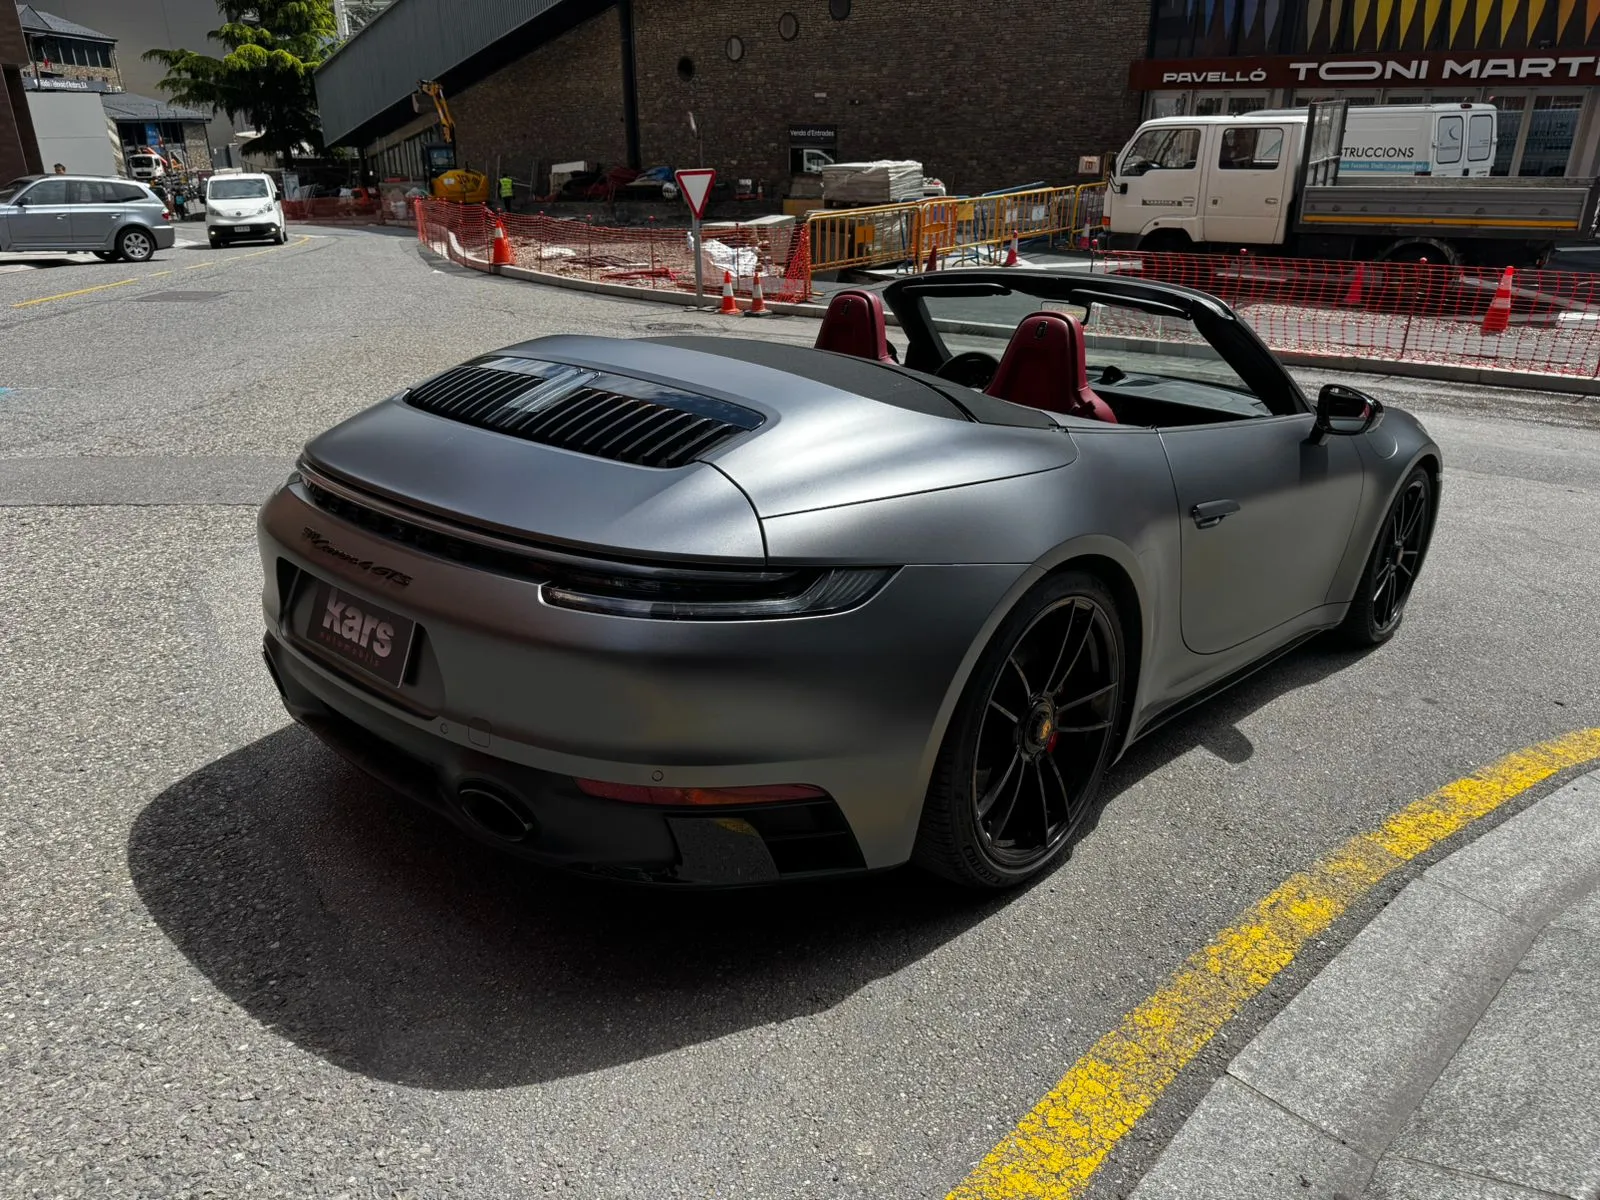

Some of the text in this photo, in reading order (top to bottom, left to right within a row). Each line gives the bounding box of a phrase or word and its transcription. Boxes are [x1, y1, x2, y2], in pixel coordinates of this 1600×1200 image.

[1162, 67, 1267, 83] PAVELLÓ
[1289, 60, 1429, 81] TONI
[322, 588, 395, 658] kars
